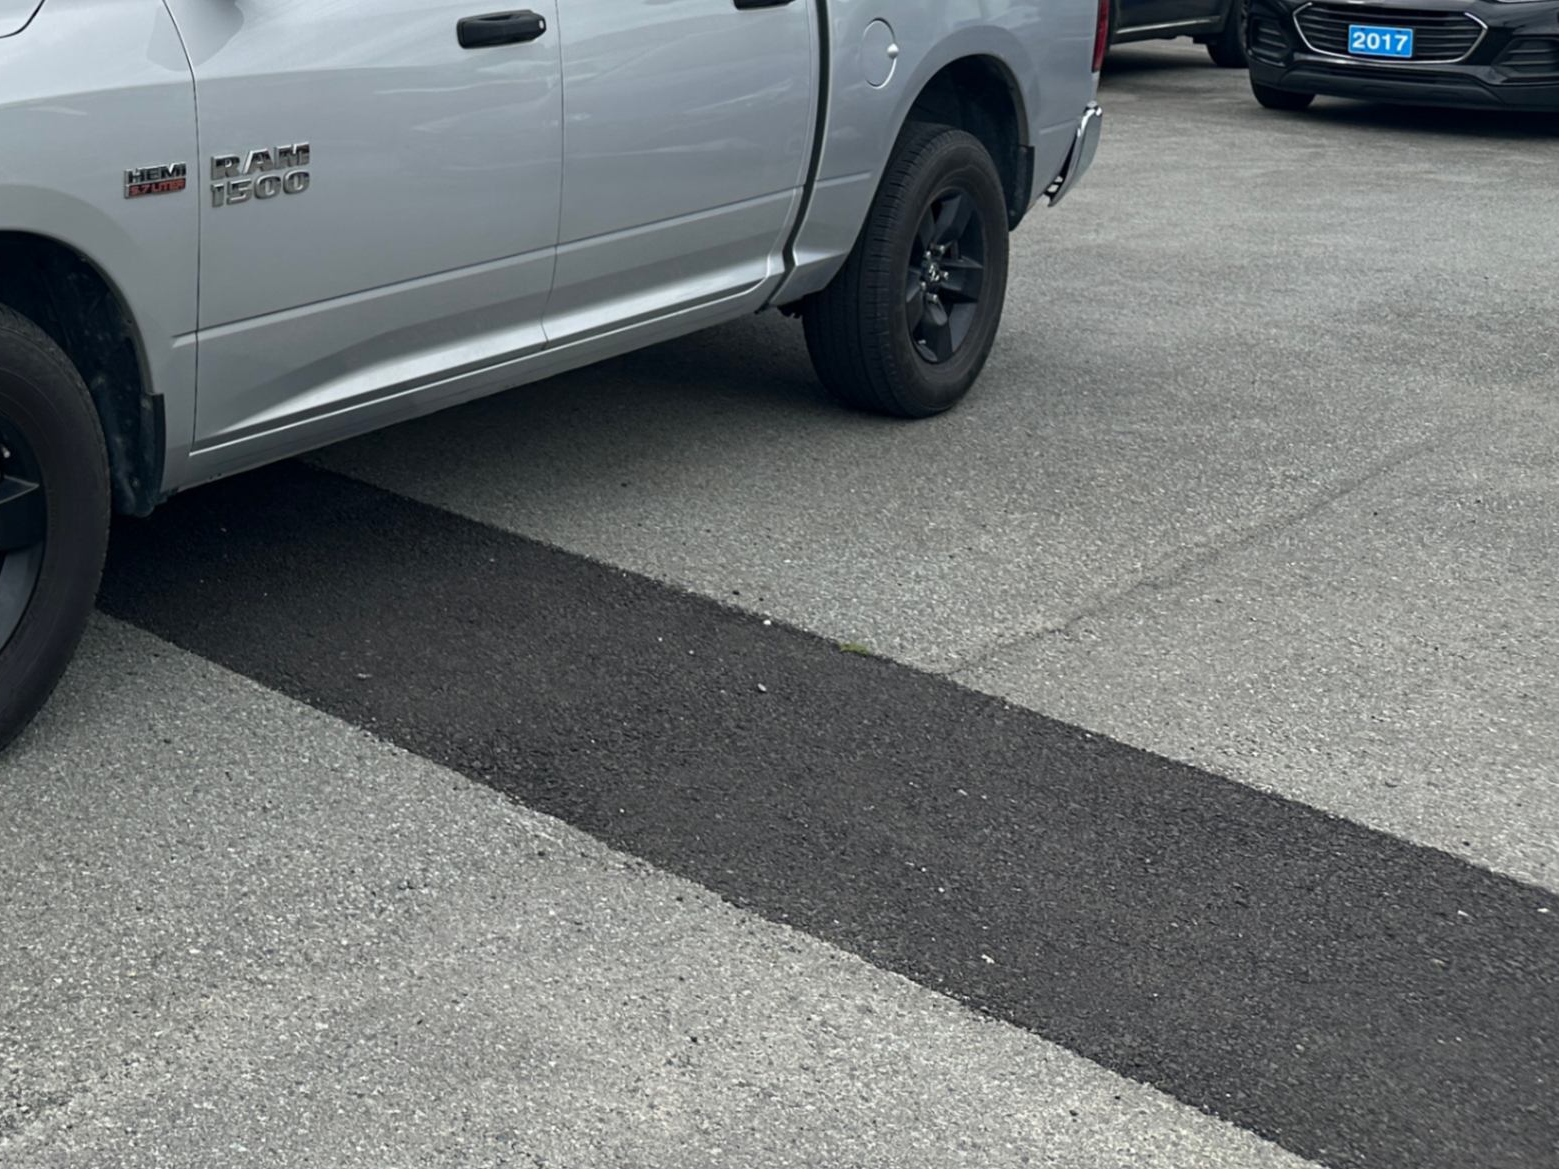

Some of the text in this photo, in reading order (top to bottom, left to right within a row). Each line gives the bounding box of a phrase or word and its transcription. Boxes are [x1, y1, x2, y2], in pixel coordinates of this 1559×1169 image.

[1352, 31, 1409, 51] 2017
[124, 162, 187, 184] HEMI
[210, 141, 310, 181] RAM
[210, 169, 310, 208] 1500
